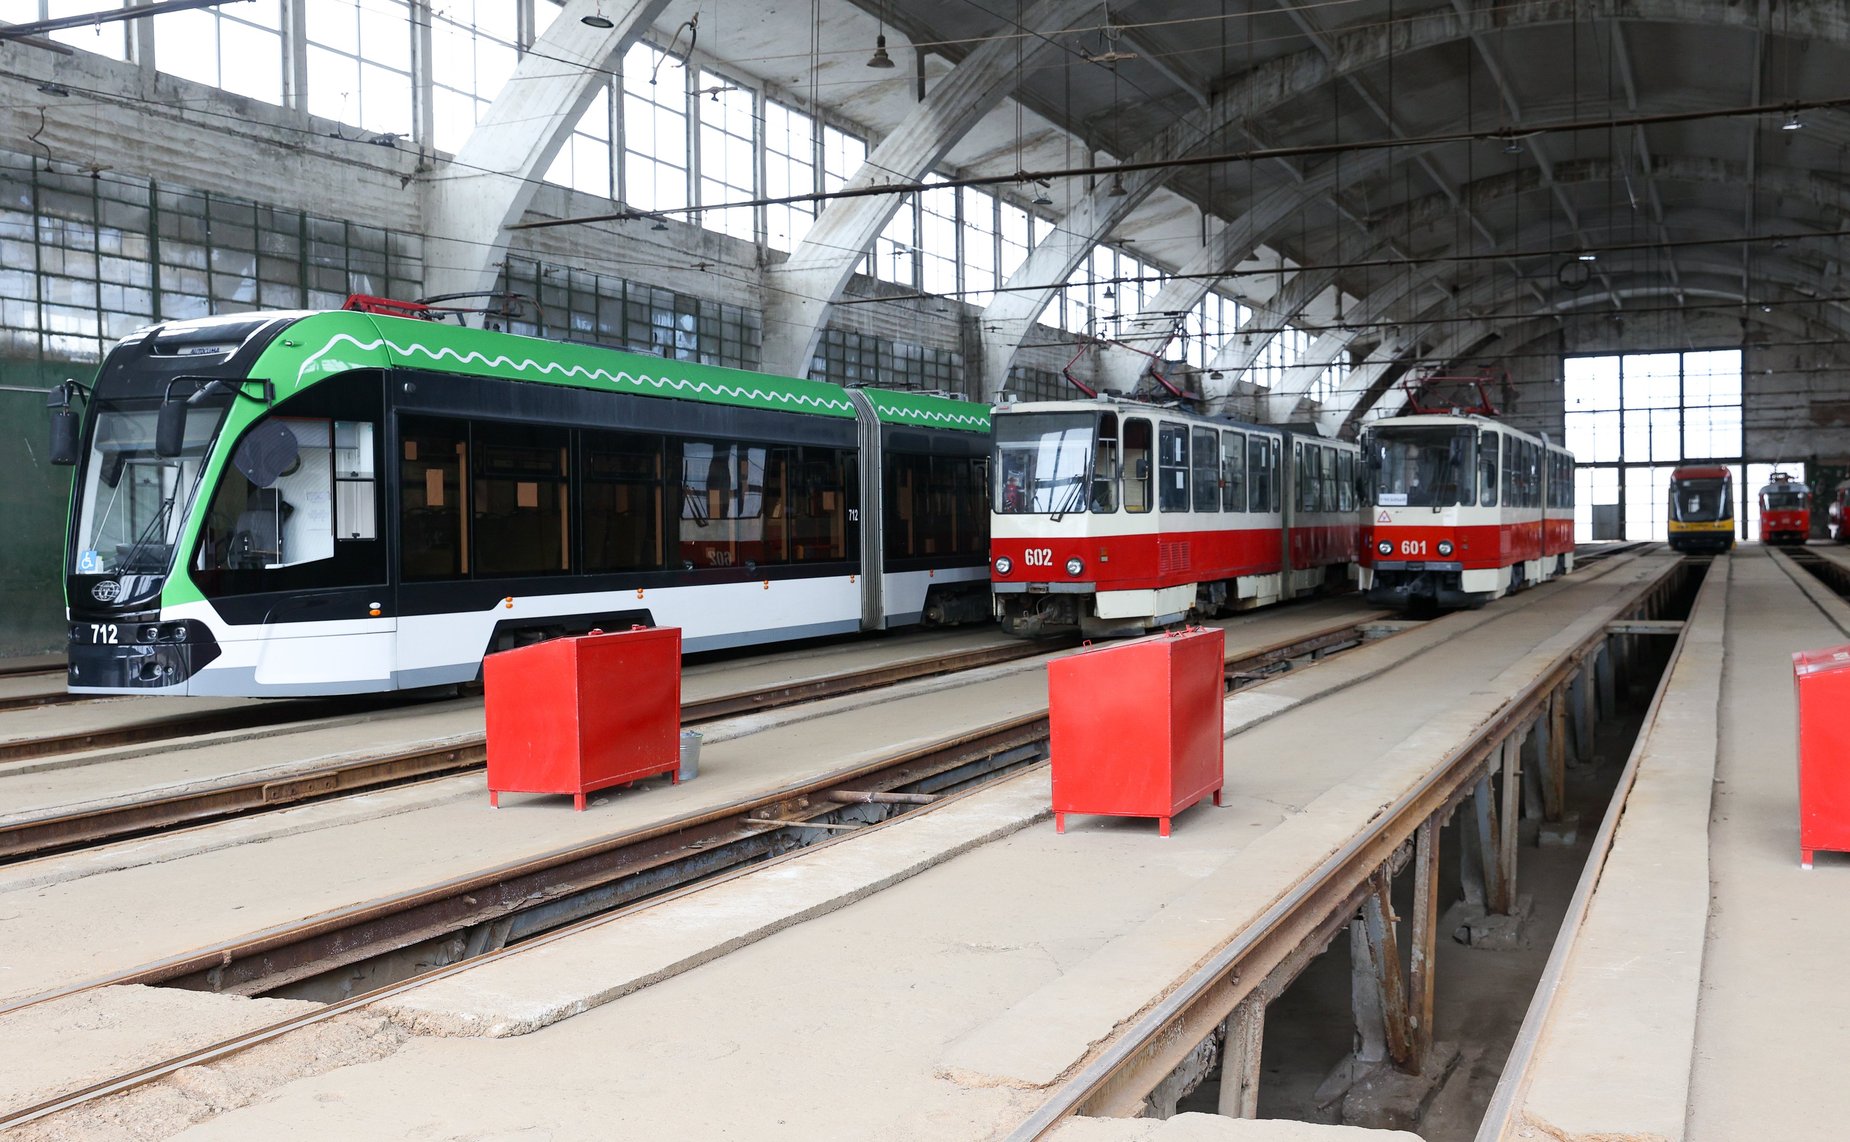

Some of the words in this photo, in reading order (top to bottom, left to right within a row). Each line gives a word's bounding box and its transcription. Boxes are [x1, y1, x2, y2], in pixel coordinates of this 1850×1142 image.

[848, 508, 859, 521] 712
[1401, 540, 1427, 555] 601
[1024, 548, 1053, 566] 602
[90, 624, 119, 644] 712
